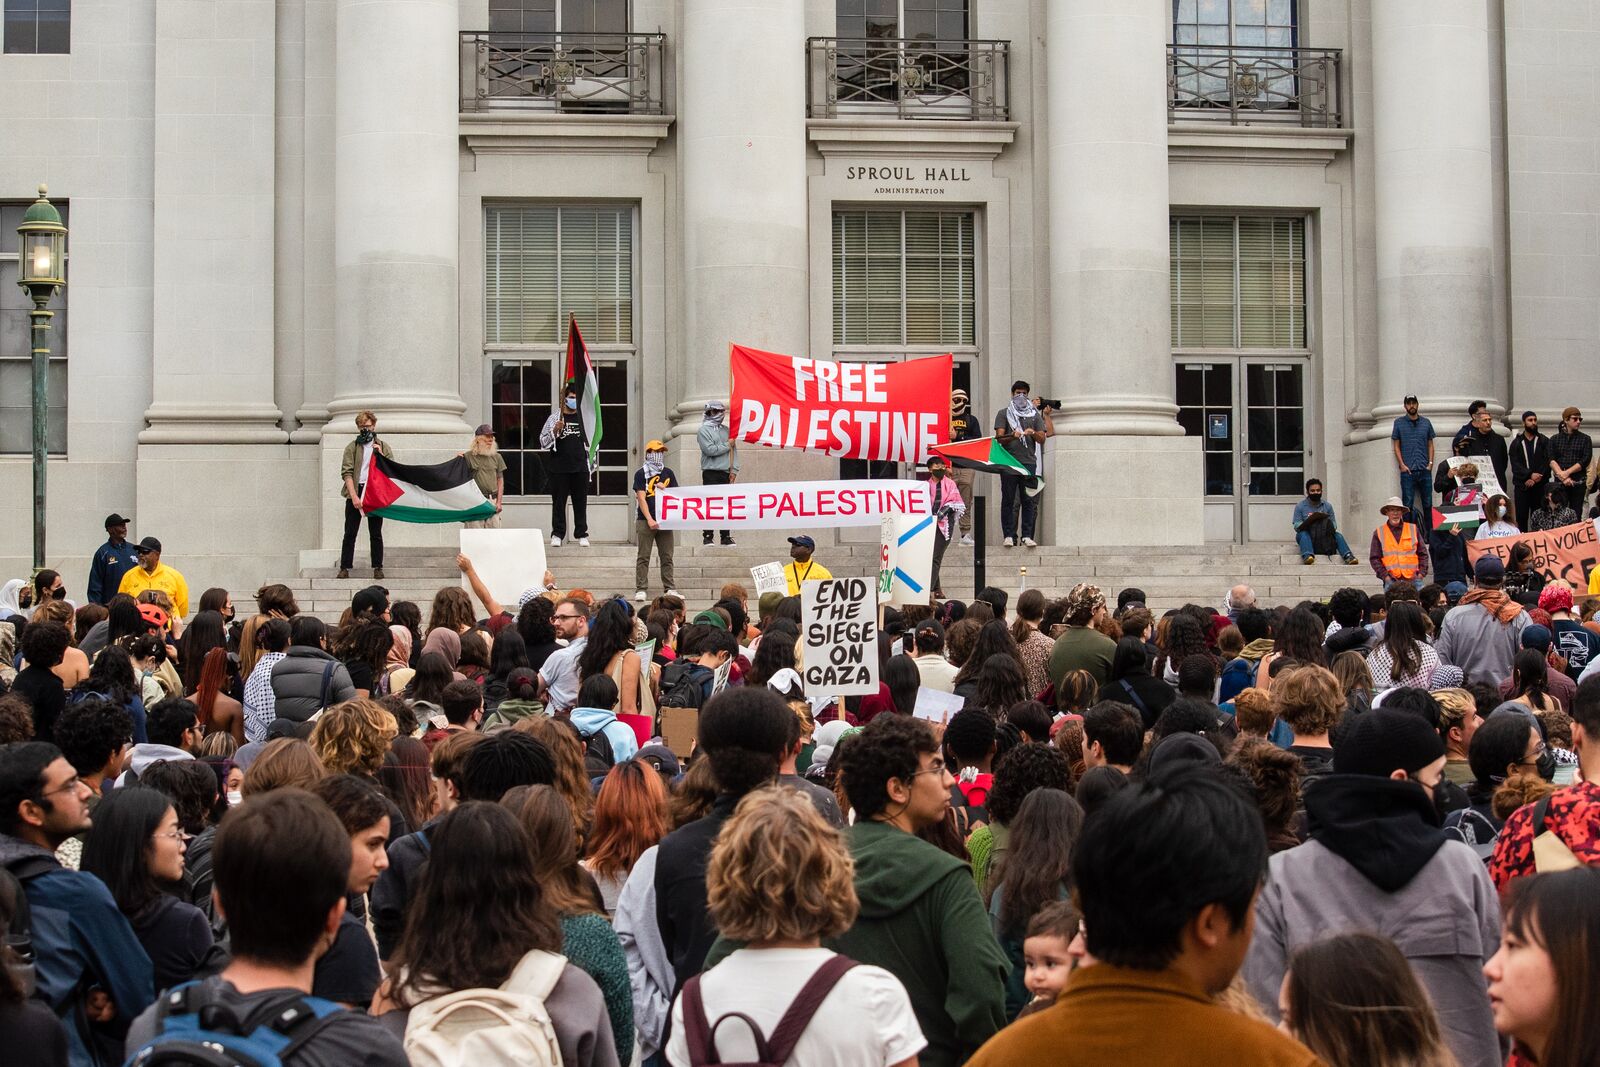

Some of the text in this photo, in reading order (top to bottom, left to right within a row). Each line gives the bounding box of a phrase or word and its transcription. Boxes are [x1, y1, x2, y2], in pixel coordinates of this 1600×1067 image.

[847, 166, 971, 181] SPROUL HALL
[874, 187, 945, 195] ADMINISTRATION
[792, 356, 887, 403] FREE
[737, 398, 939, 465] PALESTINE
[661, 489, 926, 521] FREE PALESTINE
[1553, 526, 1597, 550] VOICE
[1542, 557, 1597, 589] ACE
[816, 579, 867, 604] END
[812, 602, 862, 620] THE
[807, 621, 875, 647] SIEGE
[829, 643, 864, 665] ON
[806, 665, 871, 687] GAZA
